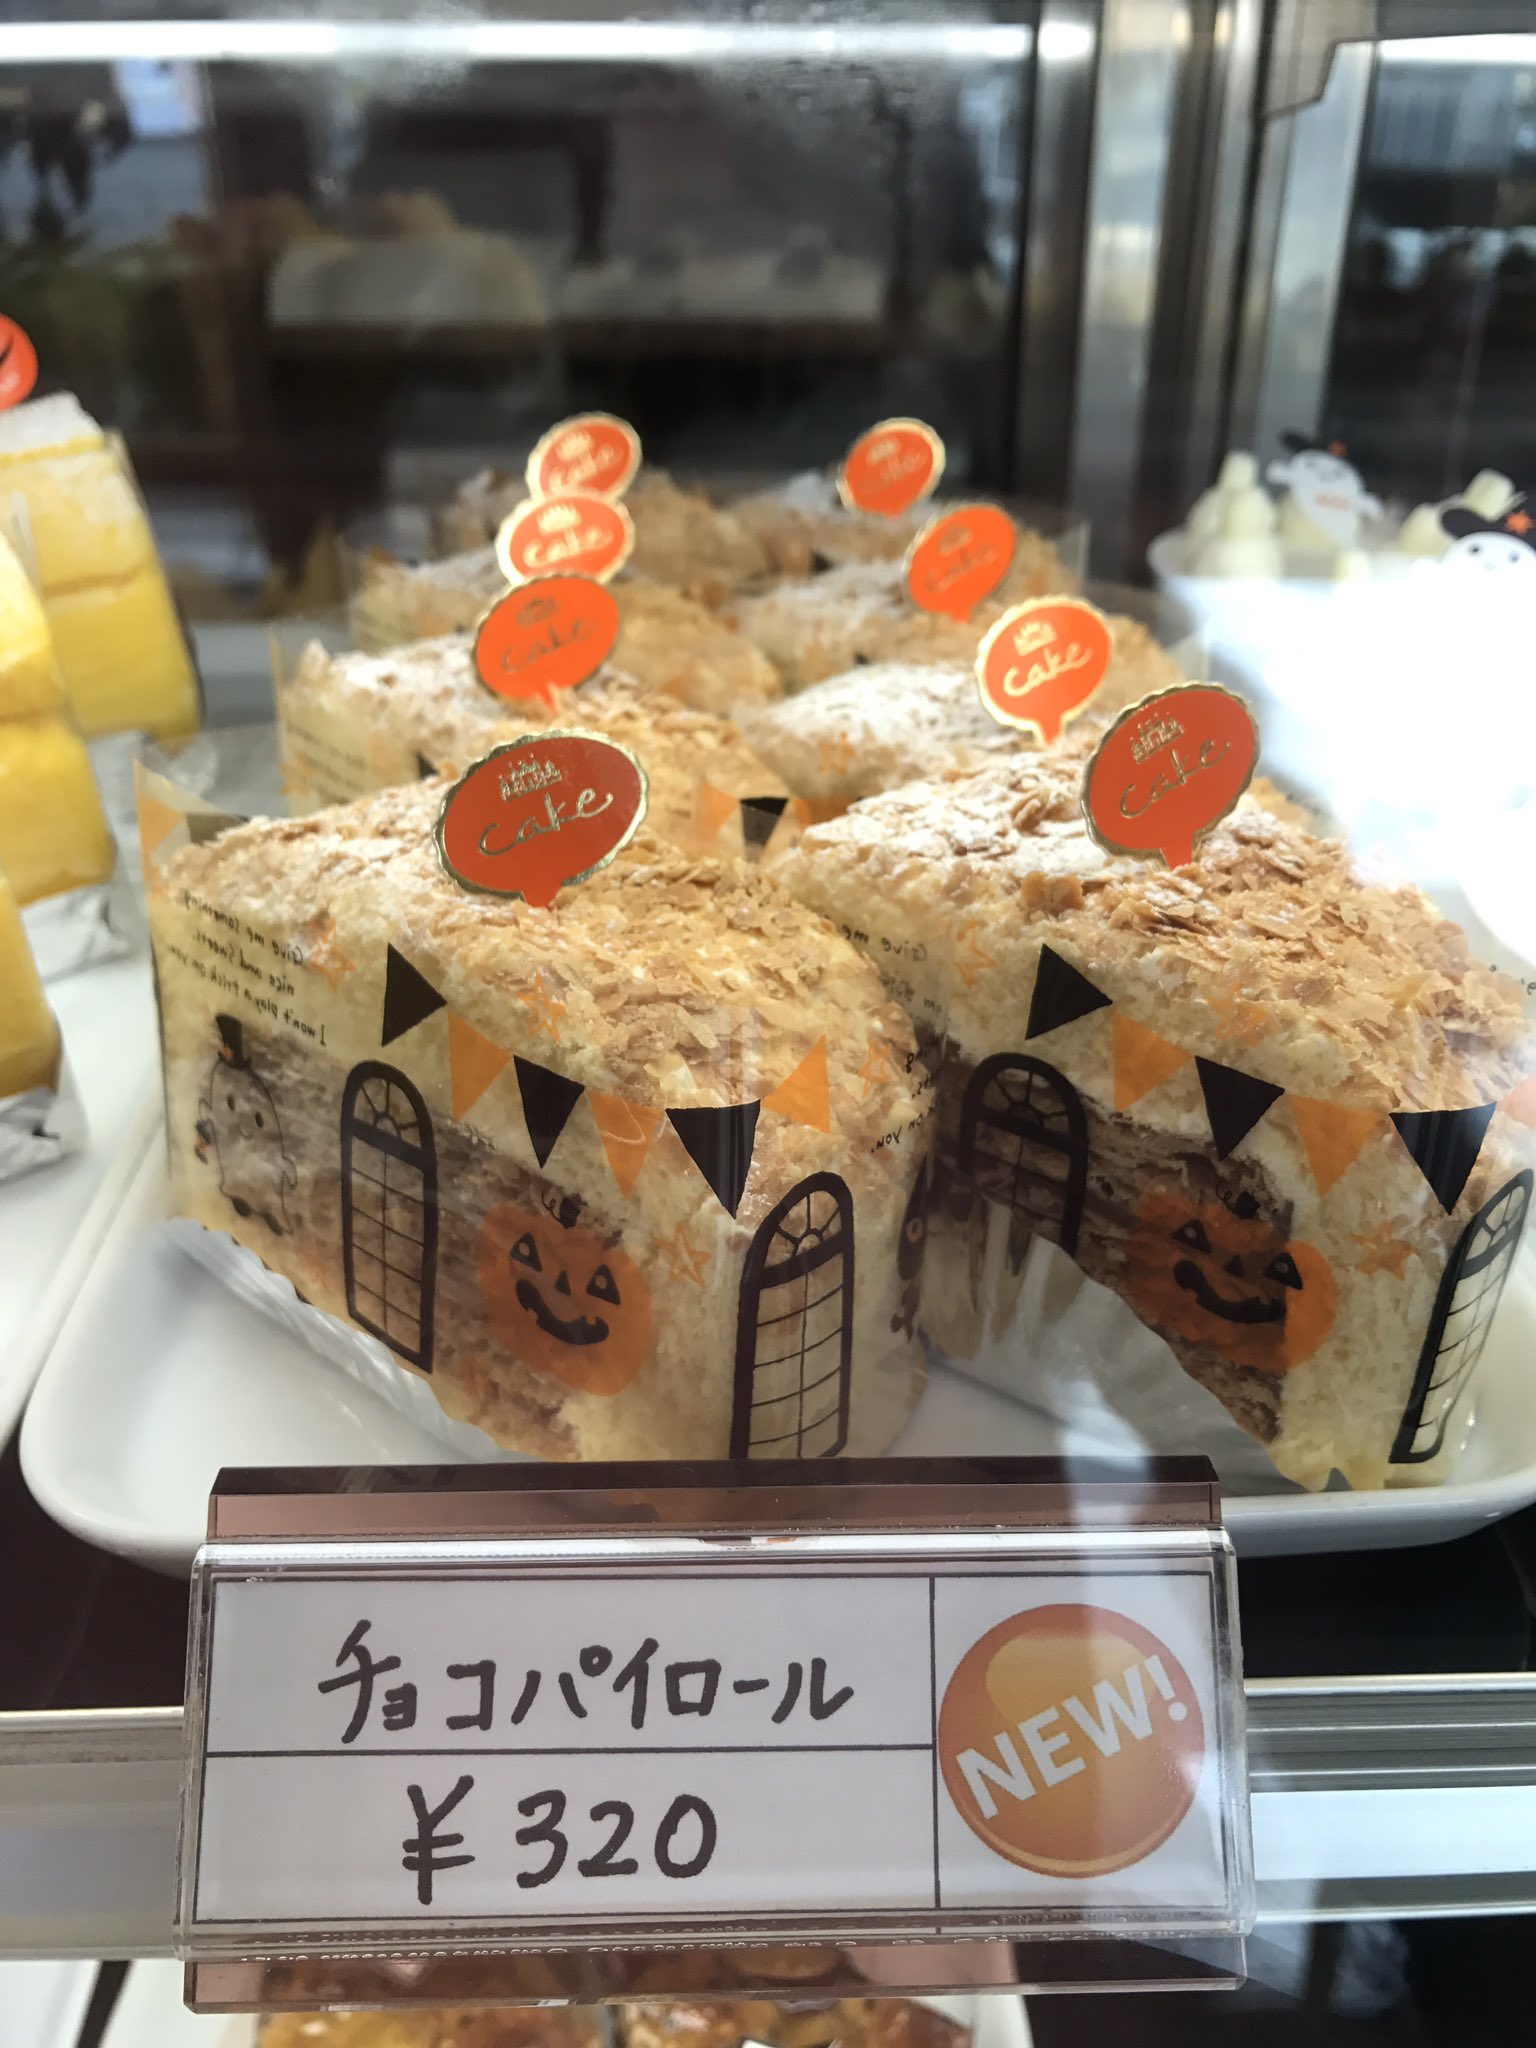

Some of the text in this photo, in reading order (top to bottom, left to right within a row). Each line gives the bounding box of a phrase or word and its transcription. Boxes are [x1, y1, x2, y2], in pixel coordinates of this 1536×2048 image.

[317, 1618, 856, 1744] チョコパイロール
[954, 1653, 1191, 1820] NEW!
